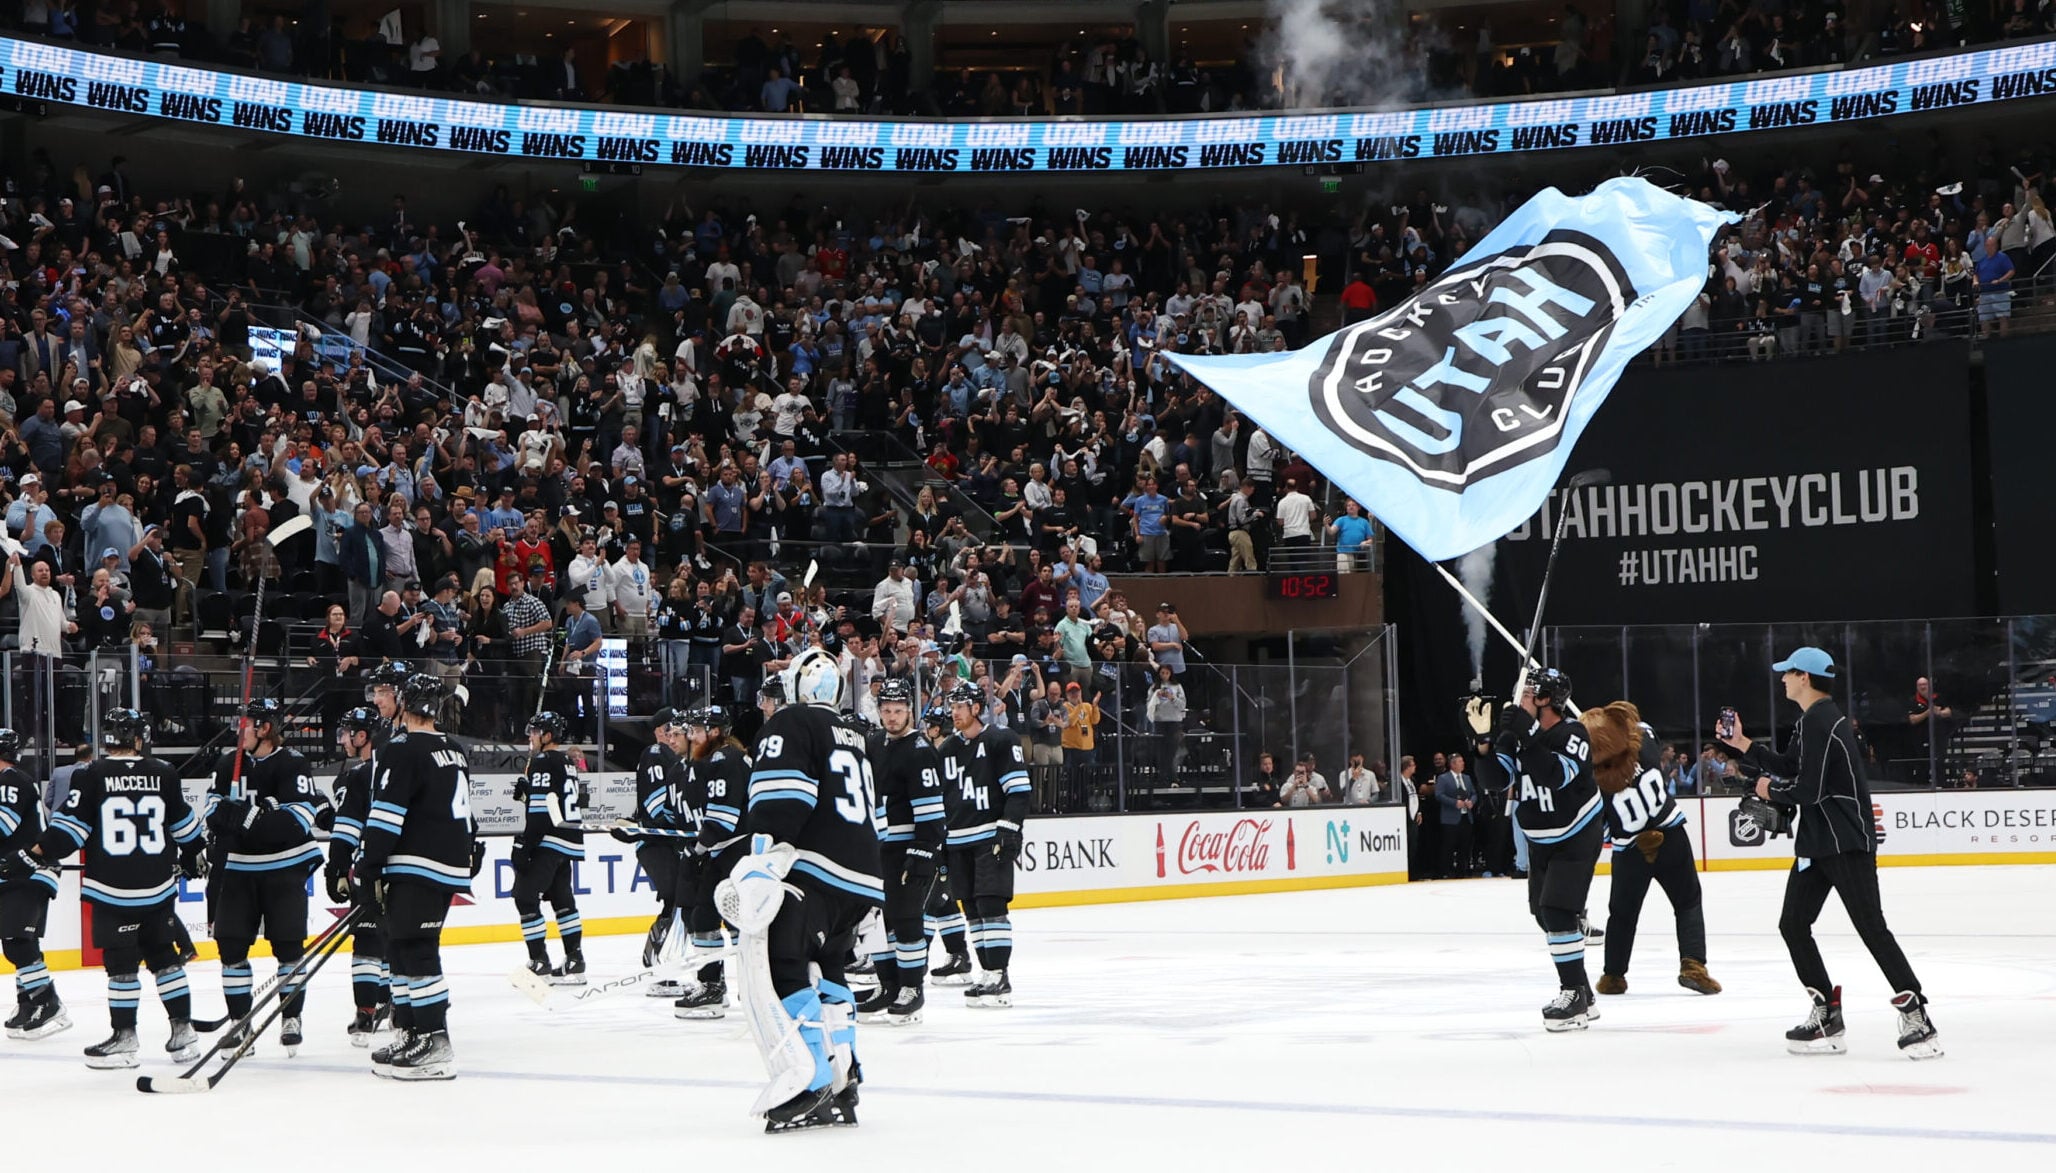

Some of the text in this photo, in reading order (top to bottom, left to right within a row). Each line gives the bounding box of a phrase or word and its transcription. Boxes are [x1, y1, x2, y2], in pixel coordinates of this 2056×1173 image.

[12, 41, 71, 75] UTAH
[84, 54, 143, 86] UTAH
[157, 66, 215, 97] UTAH
[230, 76, 286, 106] UTAH
[301, 86, 359, 114] UTAH
[374, 94, 433, 122] UTAH
[446, 101, 504, 128] UTAH
[519, 108, 579, 133] UTAH
[594, 113, 653, 137] UTAH
[668, 117, 727, 141] UTAH
[742, 120, 803, 143] UTAH
[816, 123, 877, 145] UTAH
[892, 124, 952, 146] UTAH
[967, 125, 1029, 146] UTAH
[1044, 124, 1105, 145] UTAH
[1120, 122, 1183, 144] UTAH
[1195, 120, 1258, 142] UTAH
[1274, 116, 1336, 139] UTAH
[1352, 112, 1414, 136] UTAH
[1430, 106, 1492, 131] UTAH
[1508, 100, 1572, 126] UTAH
[1586, 93, 1650, 120] UTAH
[1666, 85, 1730, 112] UTAH
[1746, 76, 1811, 104] UTAH
[1828, 65, 1891, 95] UTAH
[1908, 54, 1972, 85] UTAH
[1988, 41, 2055, 74] UTAH
[16, 68, 76, 103] WINS
[88, 80, 149, 114] WINS
[161, 92, 221, 124] WINS
[233, 102, 292, 133] WINS
[304, 111, 365, 140] WINS
[377, 119, 438, 147] WINS
[450, 126, 510, 153] WINS
[523, 132, 585, 158] WINS
[597, 137, 659, 162] WINS
[672, 141, 733, 165] WINS
[746, 144, 808, 167] WINS
[821, 146, 883, 169] WINS
[896, 147, 958, 169] WINS
[971, 148, 1035, 169] WINS
[1048, 147, 1111, 169] WINS
[1124, 145, 1188, 168] WINS
[1200, 142, 1265, 166] WINS
[1278, 138, 1342, 163] WINS
[1356, 134, 1420, 159] WINS
[1434, 129, 1499, 155] WINS
[1512, 123, 1578, 149] WINS
[1591, 116, 1657, 143] WINS
[1670, 108, 1736, 136] WINS
[1750, 99, 1817, 128] WINS
[1831, 89, 1898, 119] WINS
[1911, 78, 1979, 110] WINS
[1992, 66, 2056, 99] WINS
[1373, 266, 1596, 455] UTAH
[1619, 545, 1758, 585] #UTAHHC
[609, 650, 628, 658] WINS
[976, 742, 986, 758] A
[1565, 734, 1590, 761] 50
[105, 776, 161, 792] MACCELLI
[297, 775, 315, 796] 91
[381, 768, 391, 790] 4
[532, 773, 551, 787] 22
[707, 779, 726, 798] 38
[944, 756, 989, 811] UTAH
[1521, 774, 1555, 812] AH
[451, 770, 473, 833] 4
[1612, 768, 1667, 833] 00
[101, 795, 166, 856] 63
[1896, 811, 1974, 829] BLACK
[1046, 838, 1116, 870] BANK
[1178, 819, 1273, 875] Coca-Cola
[1360, 829, 1400, 852] Nomi
[494, 856, 657, 898] DLTA
[572, 971, 656, 999] VAPOR
